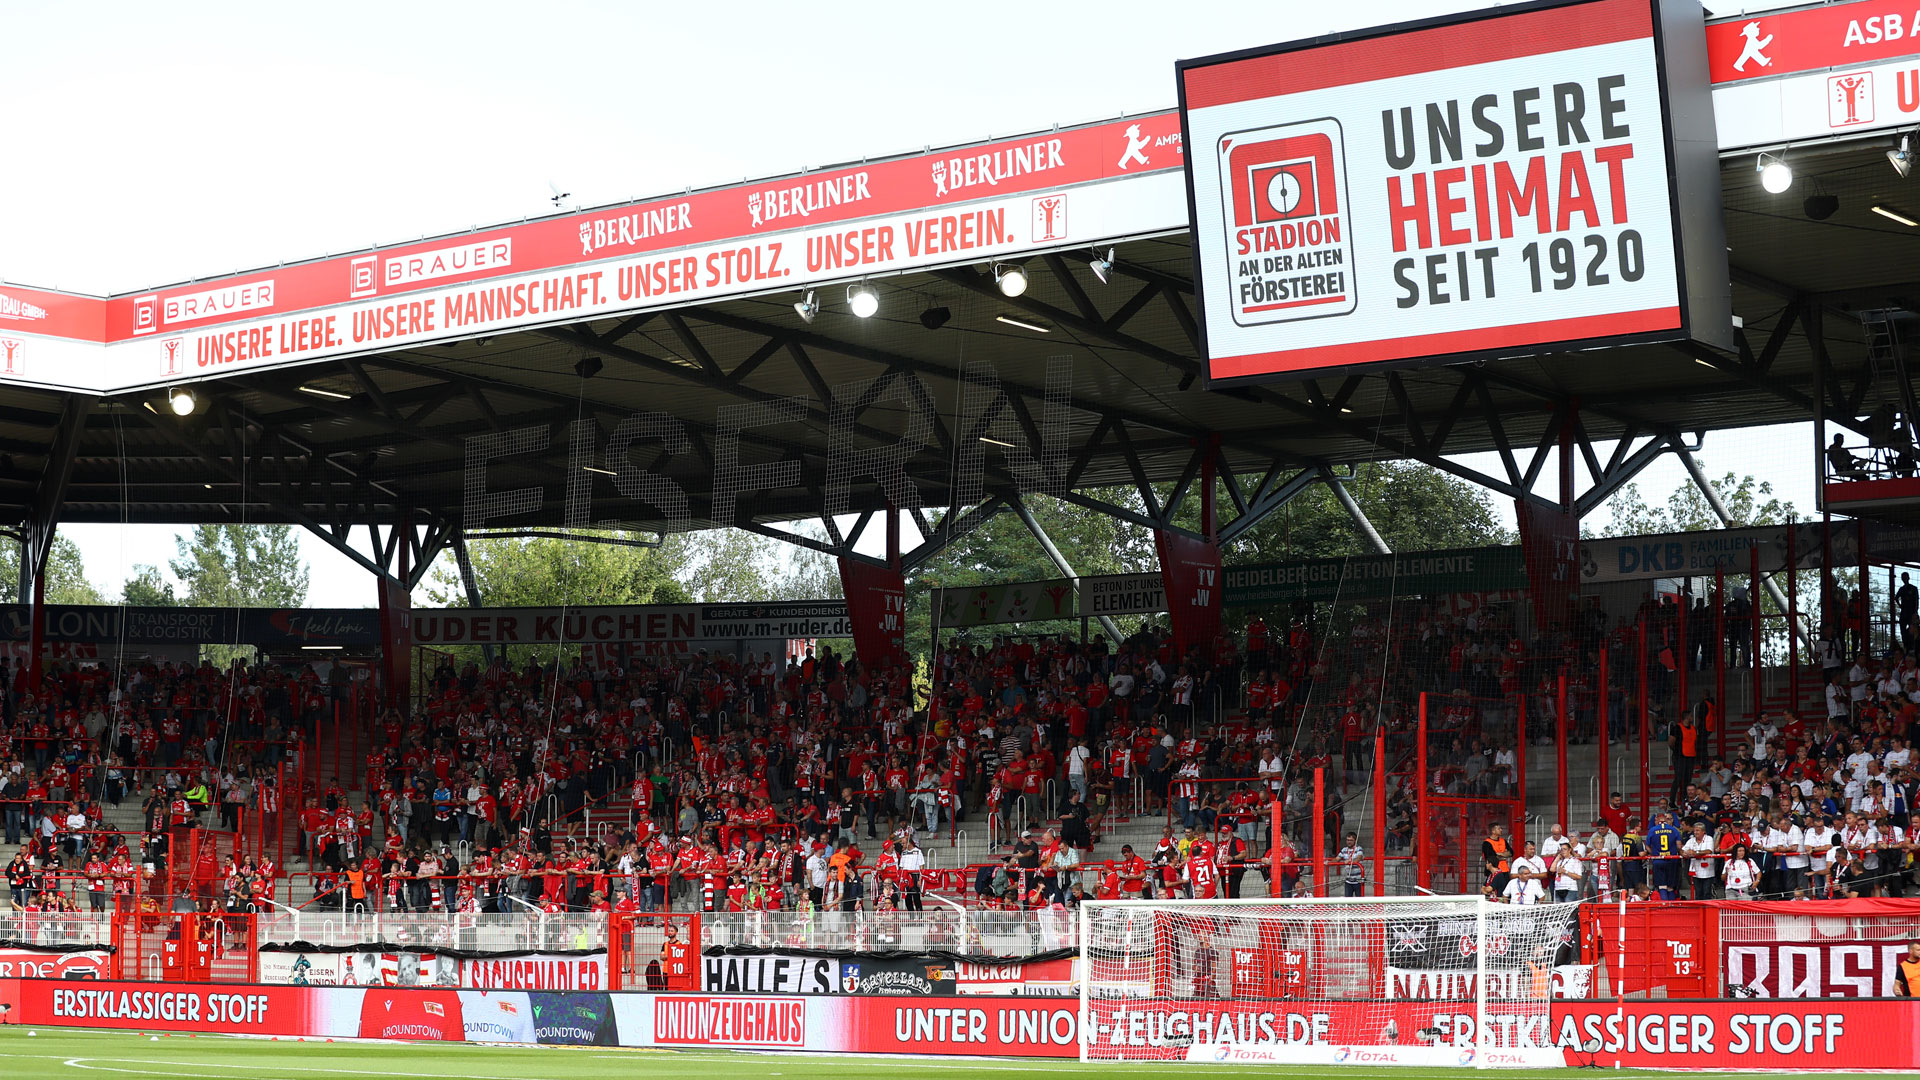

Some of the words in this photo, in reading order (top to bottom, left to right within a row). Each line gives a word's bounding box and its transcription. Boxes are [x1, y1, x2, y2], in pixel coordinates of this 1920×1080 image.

[1843, 13, 1904, 48] ASB
[1382, 74, 1631, 170] UNSERE
[949, 138, 1065, 190] BERLINER
[763, 171, 872, 222] BERLINER
[1386, 143, 1634, 253] HEIMAT
[594, 202, 693, 249] BERLINER
[1236, 217, 1341, 255] STADION
[388, 243, 508, 280] BRAUER
[1238, 258, 1260, 277] AN
[1264, 253, 1294, 274] DER
[1297, 248, 1344, 270] ALTEN
[1393, 247, 1500, 309] SEIT
[1522, 229, 1646, 294] 1920
[197, 326, 272, 367] UNSERE
[279, 315, 344, 354] LIEBE.
[352, 299, 435, 343] UNSERE
[444, 271, 607, 328] MANNSCHAFT.
[618, 256, 698, 300] UNSER
[705, 242, 790, 288] STOLZ.
[806, 225, 894, 273] UNSER
[905, 207, 1014, 257] VEREIN.
[1239, 271, 1346, 305] FÖRSTEREI
[166, 285, 272, 319] BRAUER
[463, 354, 1074, 550] EISERN
[1618, 542, 1685, 574] DKB
[1690, 554, 1736, 569] BLOCK
[1226, 563, 1338, 589] HEIDELBERGER
[1343, 555, 1474, 580] BETONELEMENTE
[1093, 581, 1122, 593] BETON
[1125, 580, 1138, 591] IST
[1093, 590, 1163, 612] ELEMENT
[129, 612, 216, 627] TRANSPORT
[710, 608, 749, 619] GERÄTE
[769, 606, 848, 618] KUNDENDIENST
[44, 611, 119, 637] LONI
[129, 625, 143, 639] &
[146, 625, 212, 640] LOGISTIK
[535, 610, 696, 641] KÜCHEN
[702, 617, 854, 638] www.m-ruder.de
[1660, 834, 1668, 851] 9
[1195, 865, 1210, 882] 21
[165, 941, 177, 952] Tor
[197, 941, 208, 952] Tor
[671, 946, 686, 959] Tor
[1672, 941, 1692, 955] Tor
[168, 956, 174, 967] 8
[200, 956, 205, 967] 9
[1235, 951, 1253, 964] Tor
[1285, 952, 1302, 965] Tor
[309, 968, 335, 976] EISERN
[471, 959, 600, 991] SACHSENADLER
[672, 963, 684, 975] 10
[1237, 969, 1249, 982] 11
[53, 989, 201, 1022] ERSTKLASSIGER
[207, 993, 269, 1024] STOFF
[382, 1024, 444, 1040] AROUNDTOWN
[535, 1026, 596, 1042] ROUNDTOWN
[896, 1008, 987, 1043] UNTER
[1728, 1013, 1844, 1054] STOFF
[1234, 1049, 1276, 1061] TOTAL
[1354, 1050, 1398, 1062] TOTAL
[1484, 1052, 1526, 1063] OTAL
